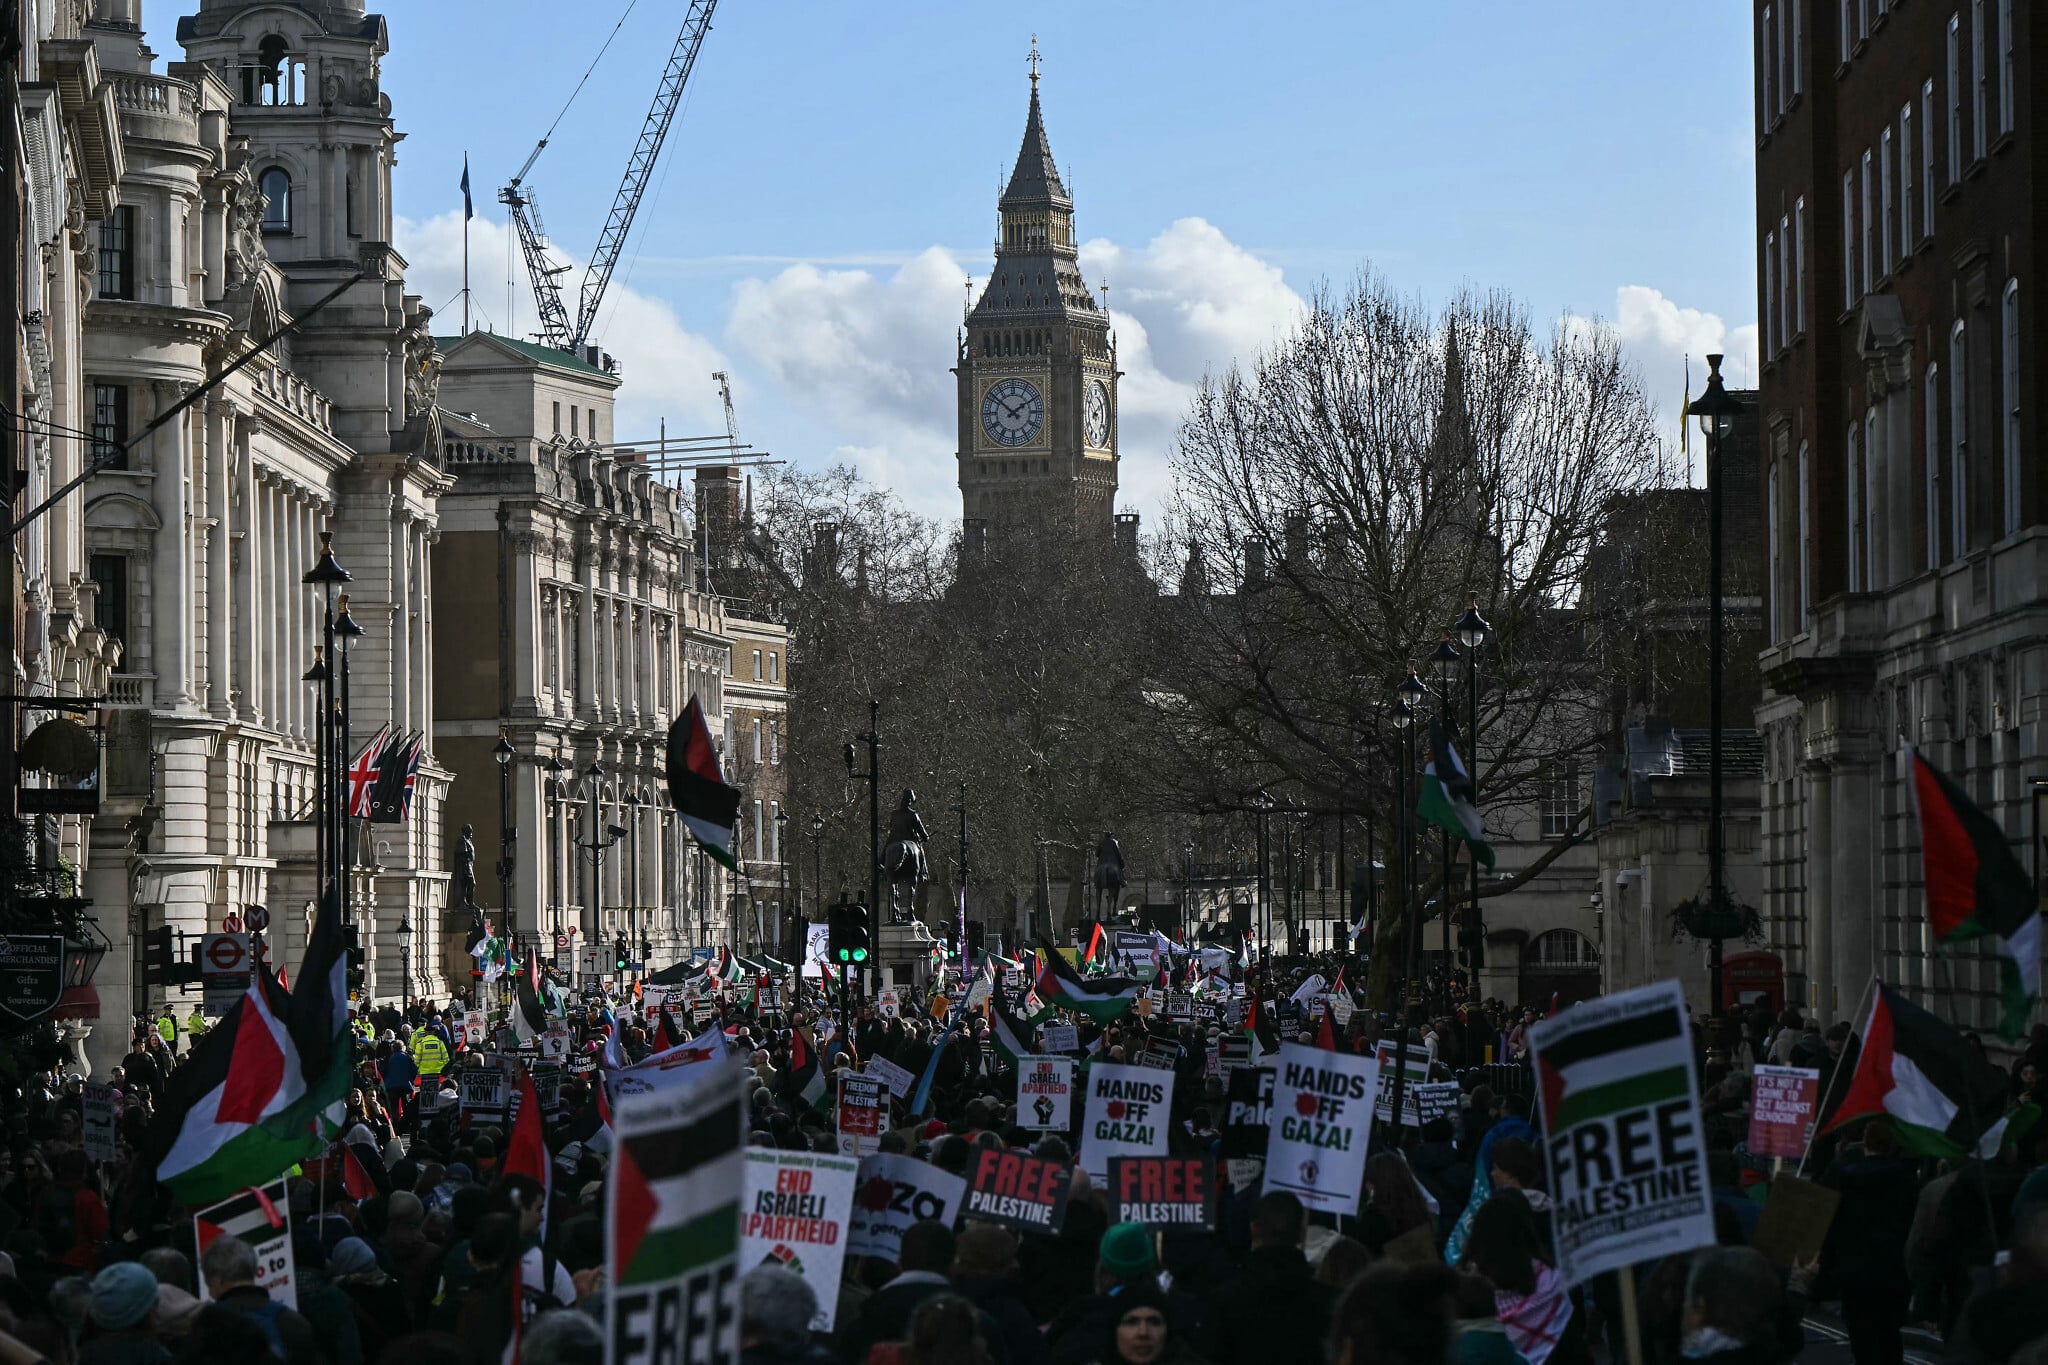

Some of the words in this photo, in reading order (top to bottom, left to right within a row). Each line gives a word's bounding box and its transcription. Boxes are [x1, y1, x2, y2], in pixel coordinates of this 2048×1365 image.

[226, 919, 240, 933] N
[247, 911, 265, 928] M
[10, 943, 48, 953] OFFICIAL
[16, 975, 39, 985] Gifts
[23, 987, 32, 995] &
[7, 996, 47, 1005] Souvenirs
[568, 1062, 598, 1074] Palestin
[574, 1056, 591, 1065] Free
[1037, 1062, 1053, 1073] END
[1029, 1073, 1060, 1084] ISRAELI
[1284, 1061, 1366, 1101] HANDS
[1757, 1076, 1776, 1087] IT'S
[1776, 1078, 1795, 1089] NOT
[1796, 1079, 1804, 1090] A
[86, 1087, 111, 1101] STOP
[468, 1086, 498, 1103] NOW!
[846, 1081, 879, 1094] FREEDOM
[1021, 1083, 1068, 1095] APARTHEID
[1096, 1078, 1164, 1104] HANDS
[1757, 1087, 1785, 1099] CRIME
[1786, 1090, 1799, 1101] TO
[843, 1095, 880, 1108] PALESTINE
[1435, 1098, 1458, 1107] blood
[1755, 1098, 1773, 1110] ACT
[1775, 1101, 1811, 1114] AGAINST
[1754, 1109, 1798, 1125] GENOCIDE
[86, 1133, 113, 1146] ISRAEL
[1094, 1120, 1155, 1146] GAZA!
[1281, 1116, 1353, 1152] GAZA!
[1550, 1100, 1698, 1203] FREE
[777, 1168, 812, 1194] END
[974, 1148, 1062, 1206] FREE
[1119, 1159, 1204, 1202] FREE
[757, 1190, 826, 1219] ISRAELI
[969, 1189, 1053, 1225] PALESTINE
[1558, 1163, 1703, 1237] PALESTINE
[1120, 1202, 1204, 1224] PALESTINE
[269, 1257, 286, 1273] to
